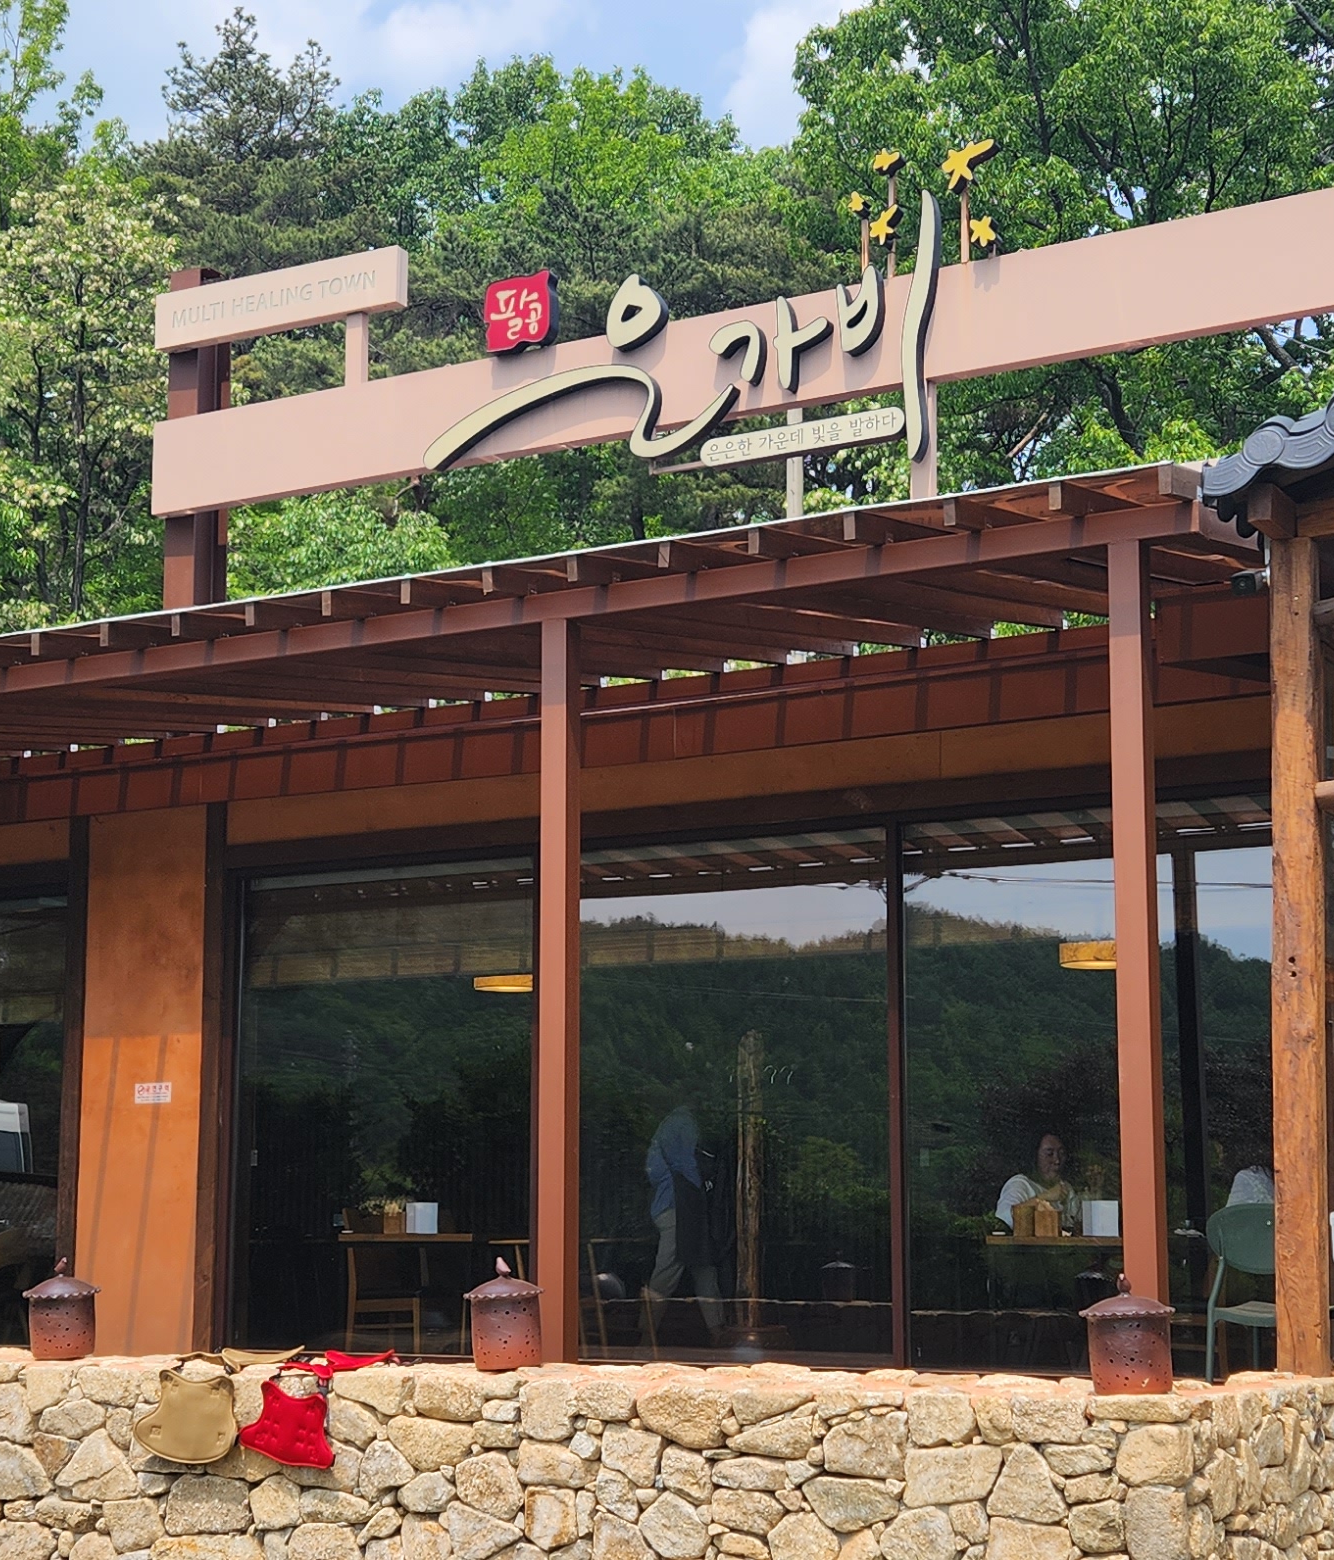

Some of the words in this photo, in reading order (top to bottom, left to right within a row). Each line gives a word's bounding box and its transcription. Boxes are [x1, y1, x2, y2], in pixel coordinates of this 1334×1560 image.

[171, 300, 225, 329] MULTI
[231, 283, 313, 317] HEALING
[317, 270, 376, 298] TOWN
[490, 288, 542, 340] 팔공
[422, 189, 939, 468] 은가비
[706, 437, 753, 462] 은은한
[759, 427, 805, 452] 가운데
[812, 421, 842, 445] 빛을
[849, 411, 898, 438] 발하다
